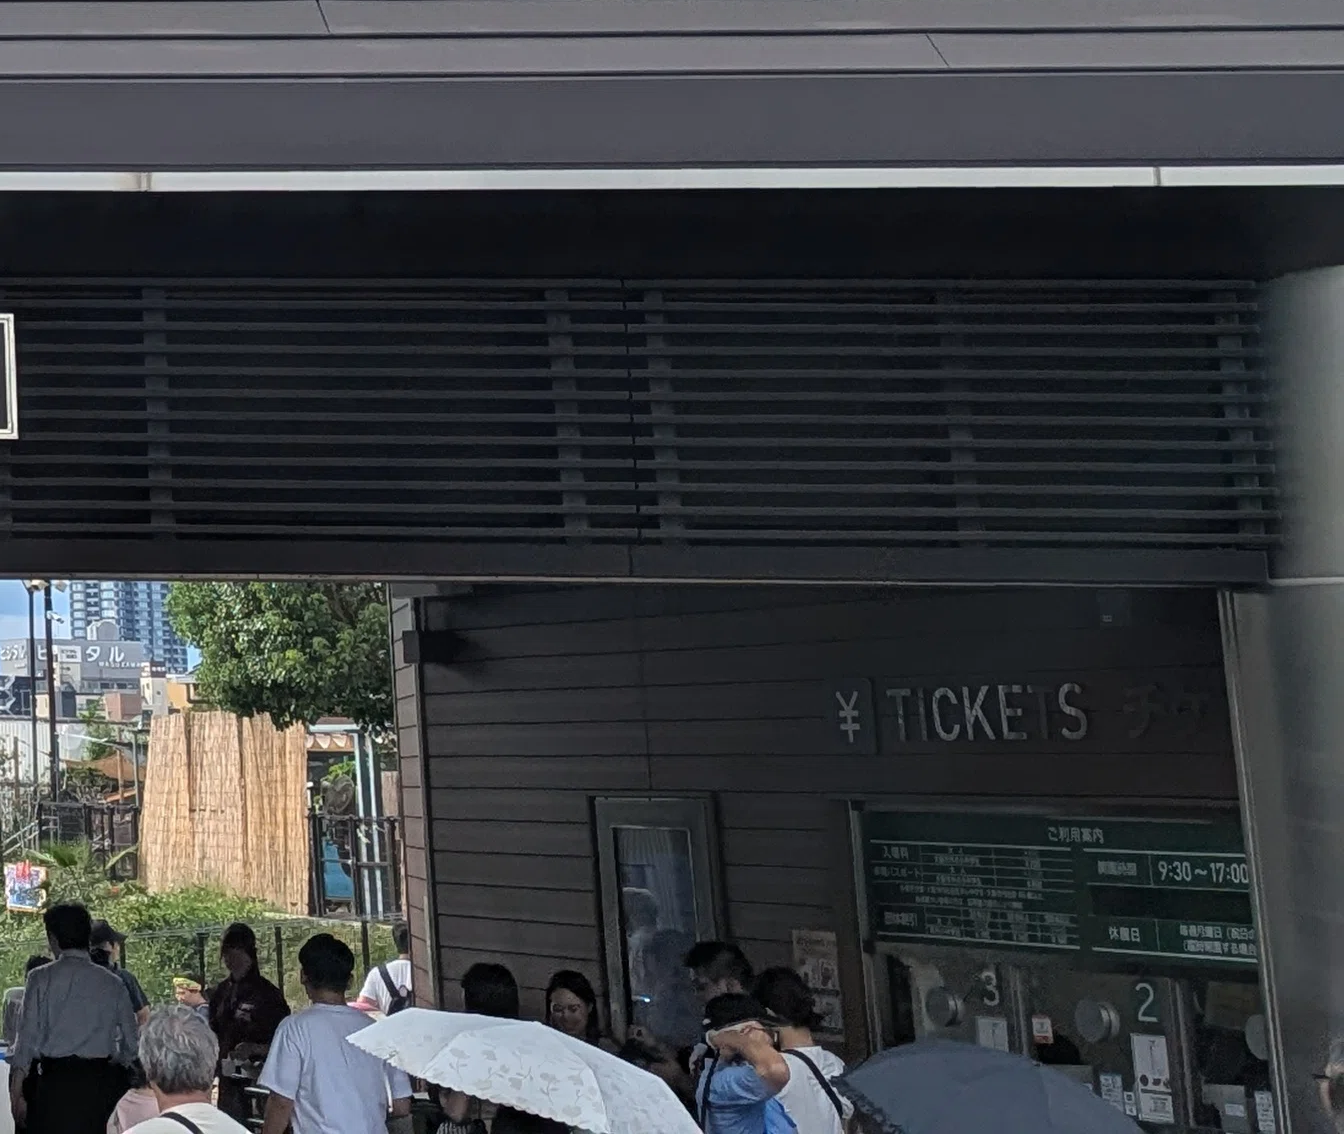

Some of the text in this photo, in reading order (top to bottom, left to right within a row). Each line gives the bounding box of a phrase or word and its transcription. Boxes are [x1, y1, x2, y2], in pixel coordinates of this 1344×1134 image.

[885, 681, 1090, 743] TICKETS
[981, 971, 1000, 1007] 3
[1135, 982, 1159, 1023] 2
